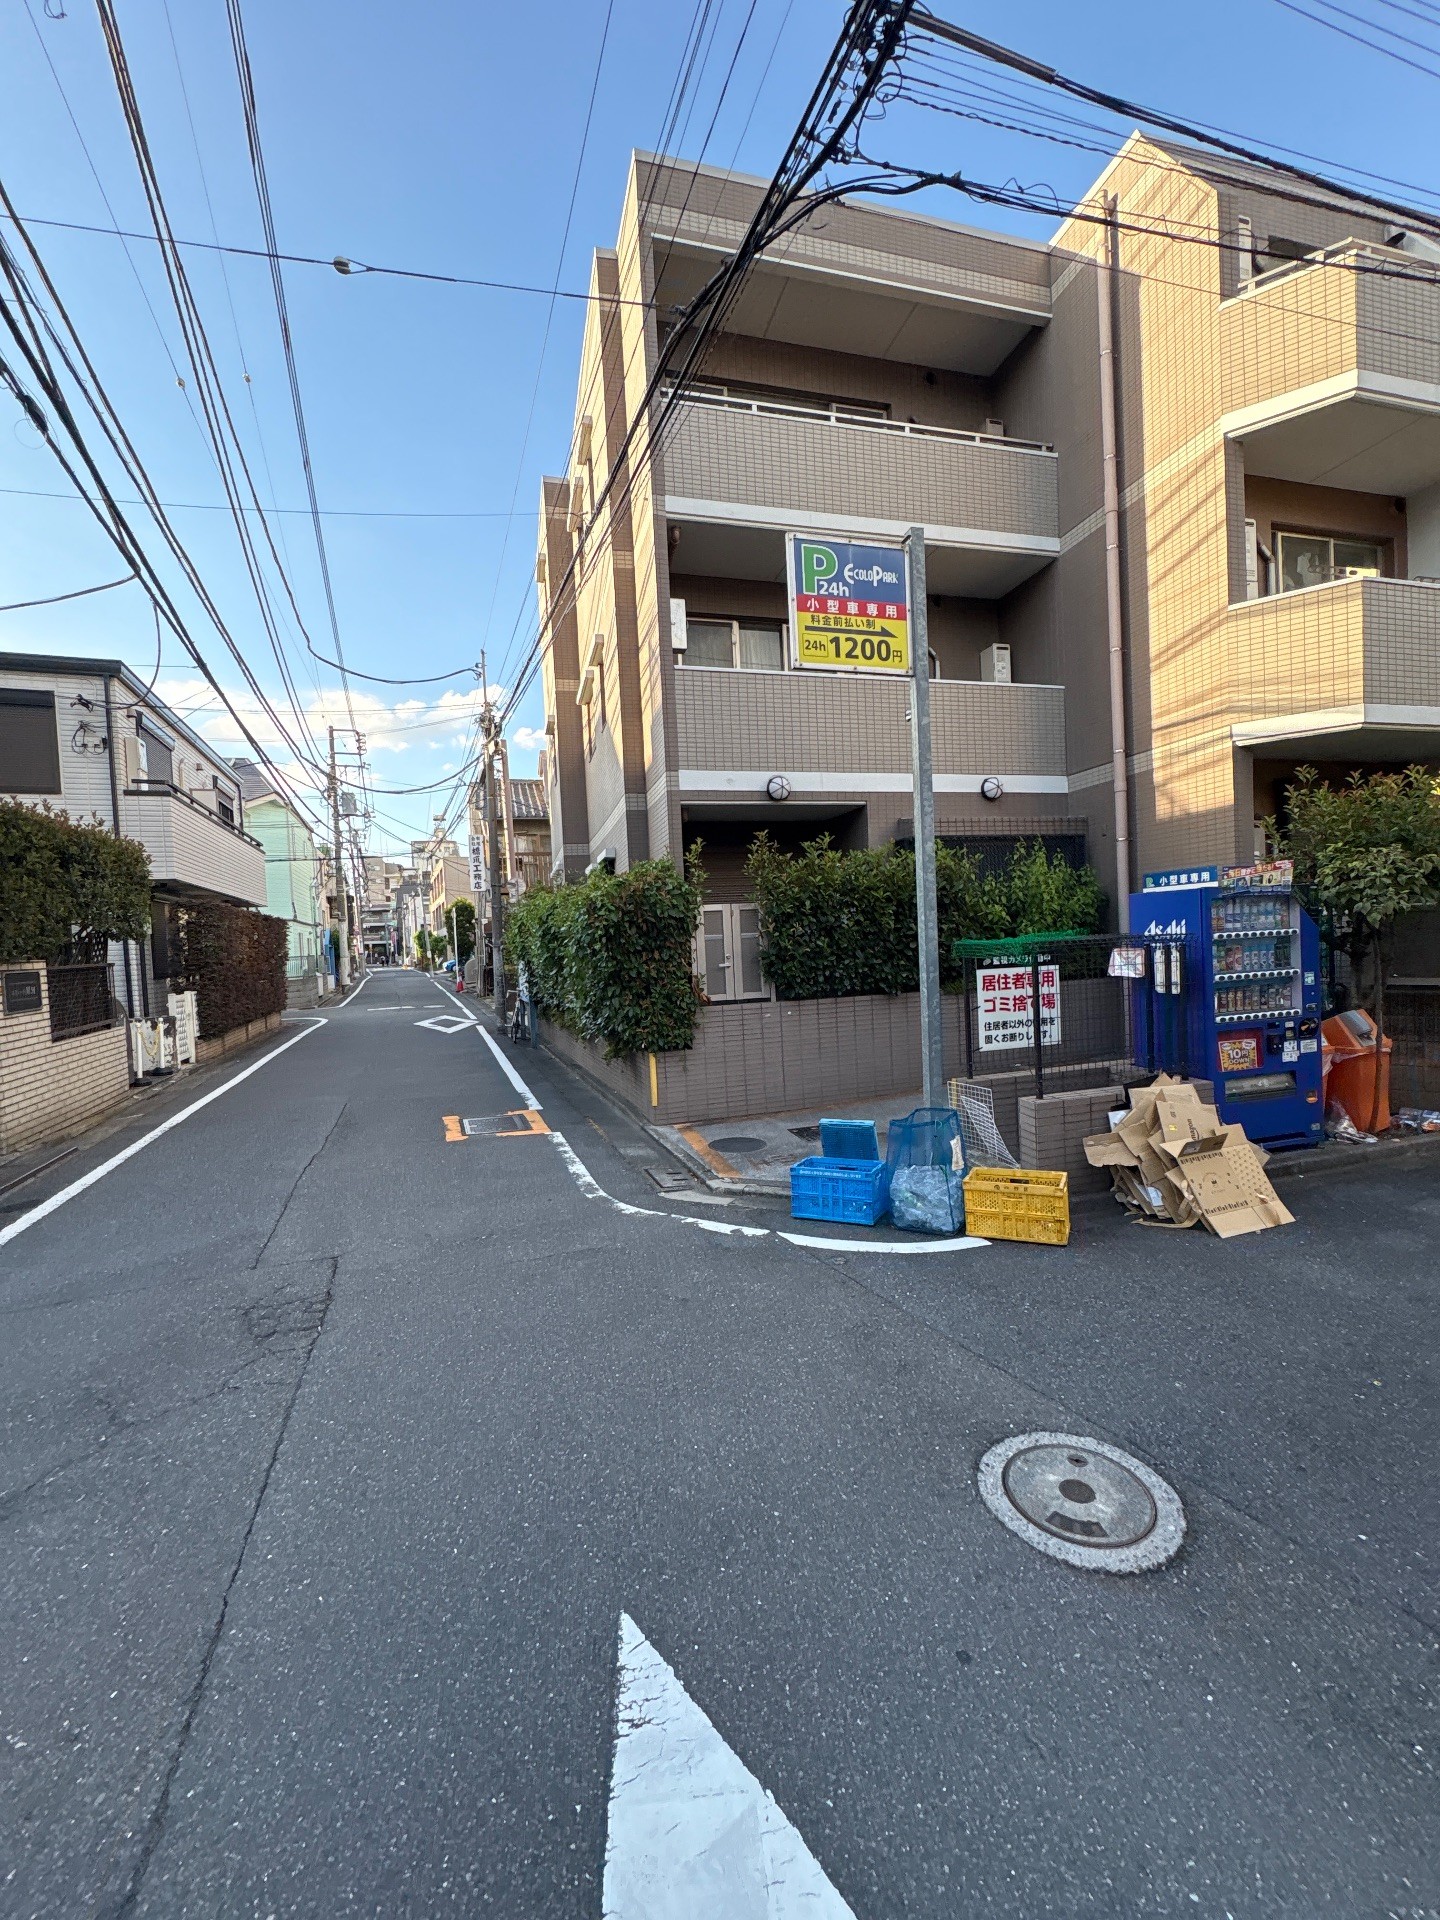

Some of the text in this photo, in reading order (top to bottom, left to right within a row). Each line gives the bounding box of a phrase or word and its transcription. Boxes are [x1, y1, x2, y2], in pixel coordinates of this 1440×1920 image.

[801, 543, 838, 596] P
[819, 581, 850, 597] 24h
[807, 597, 898, 619] 小型車専用
[811, 614, 876, 630] 料金前払い制
[804, 639, 826, 652] 24h
[1159, 871, 1210, 886] 小型車専用
[1144, 919, 1186, 936] Asahi
[984, 1017, 1056, 1032] 住居者以外の用を
[985, 1030, 1053, 1045] 固くお断りしす。
